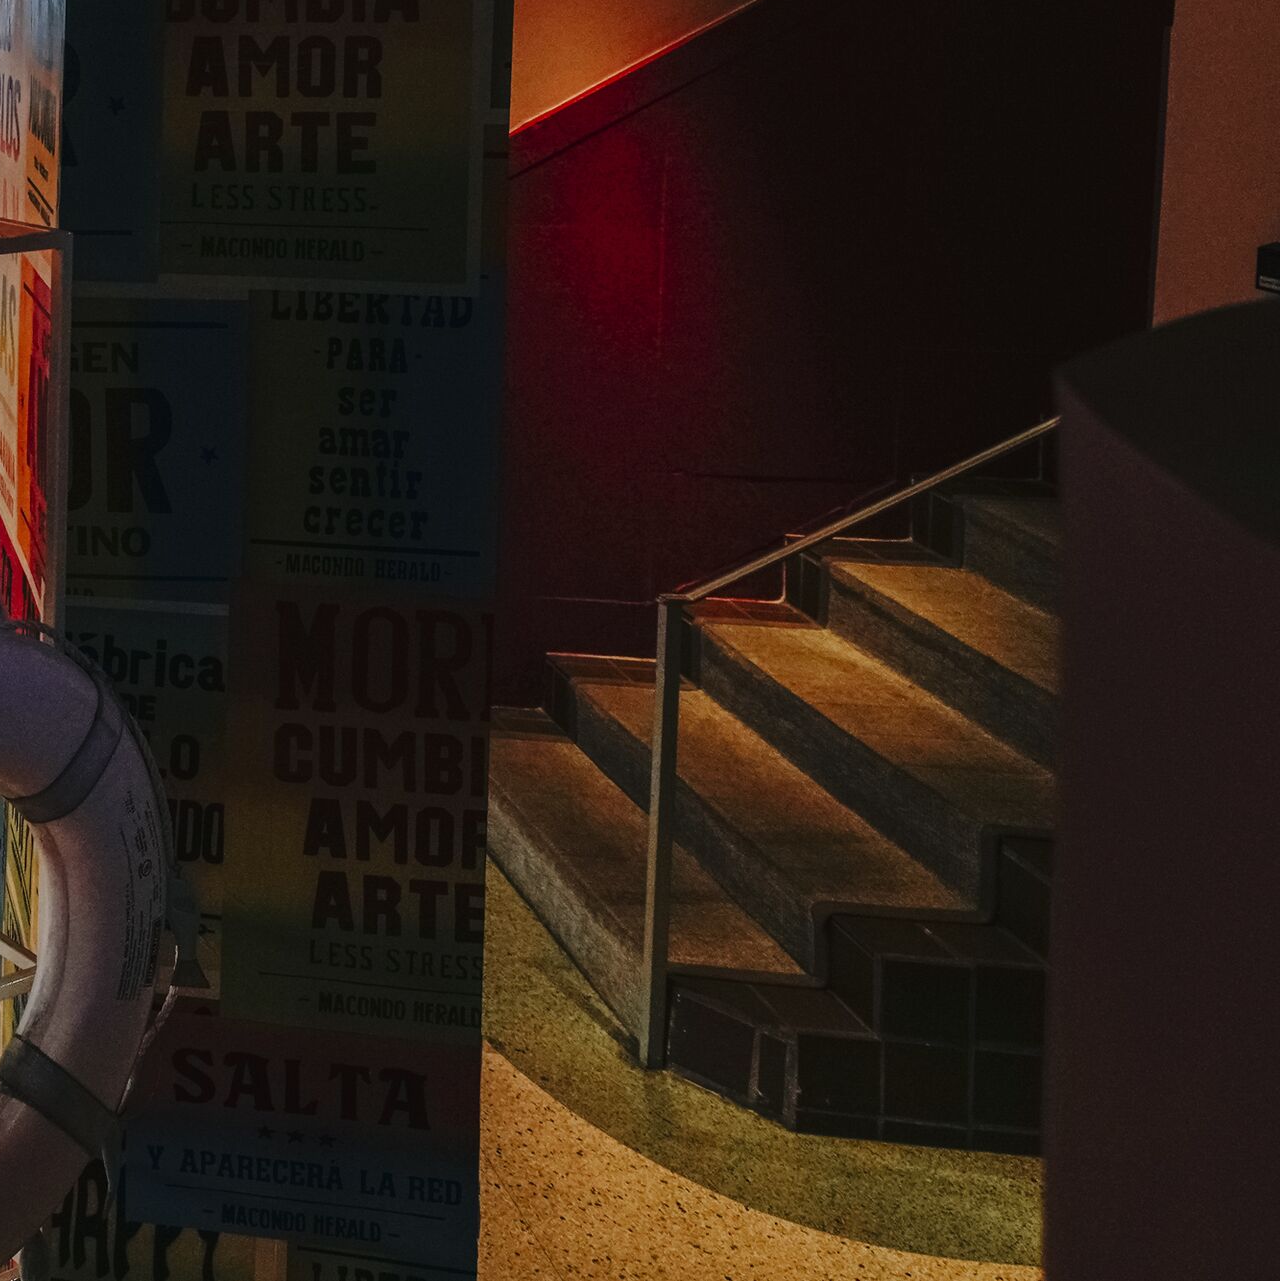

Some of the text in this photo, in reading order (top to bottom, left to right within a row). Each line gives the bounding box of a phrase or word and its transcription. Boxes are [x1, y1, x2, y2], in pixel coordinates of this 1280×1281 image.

[185, 35, 383, 99] AMOR
[193, 110, 378, 175] ARTE
[191, 182, 255, 211] LESS
[200, 235, 365, 262] MACONDO HERALD
[270, 290, 474, 328] LIBERTAD
[337, 386, 398, 417] ser
[318, 426, 410, 458] amar
[308, 462, 423, 500] sentir
[303, 506, 429, 540] crecer
[311, 870, 486, 943] ARTE
[309, 939, 373, 970] LESS
[318, 991, 406, 1021] MACONDO
[171, 1047, 432, 1131] SALTA
[146, 1144, 463, 1206] Y APARECERÁ LA RED
[221, 1203, 382, 1243] MACONDO HERALD
